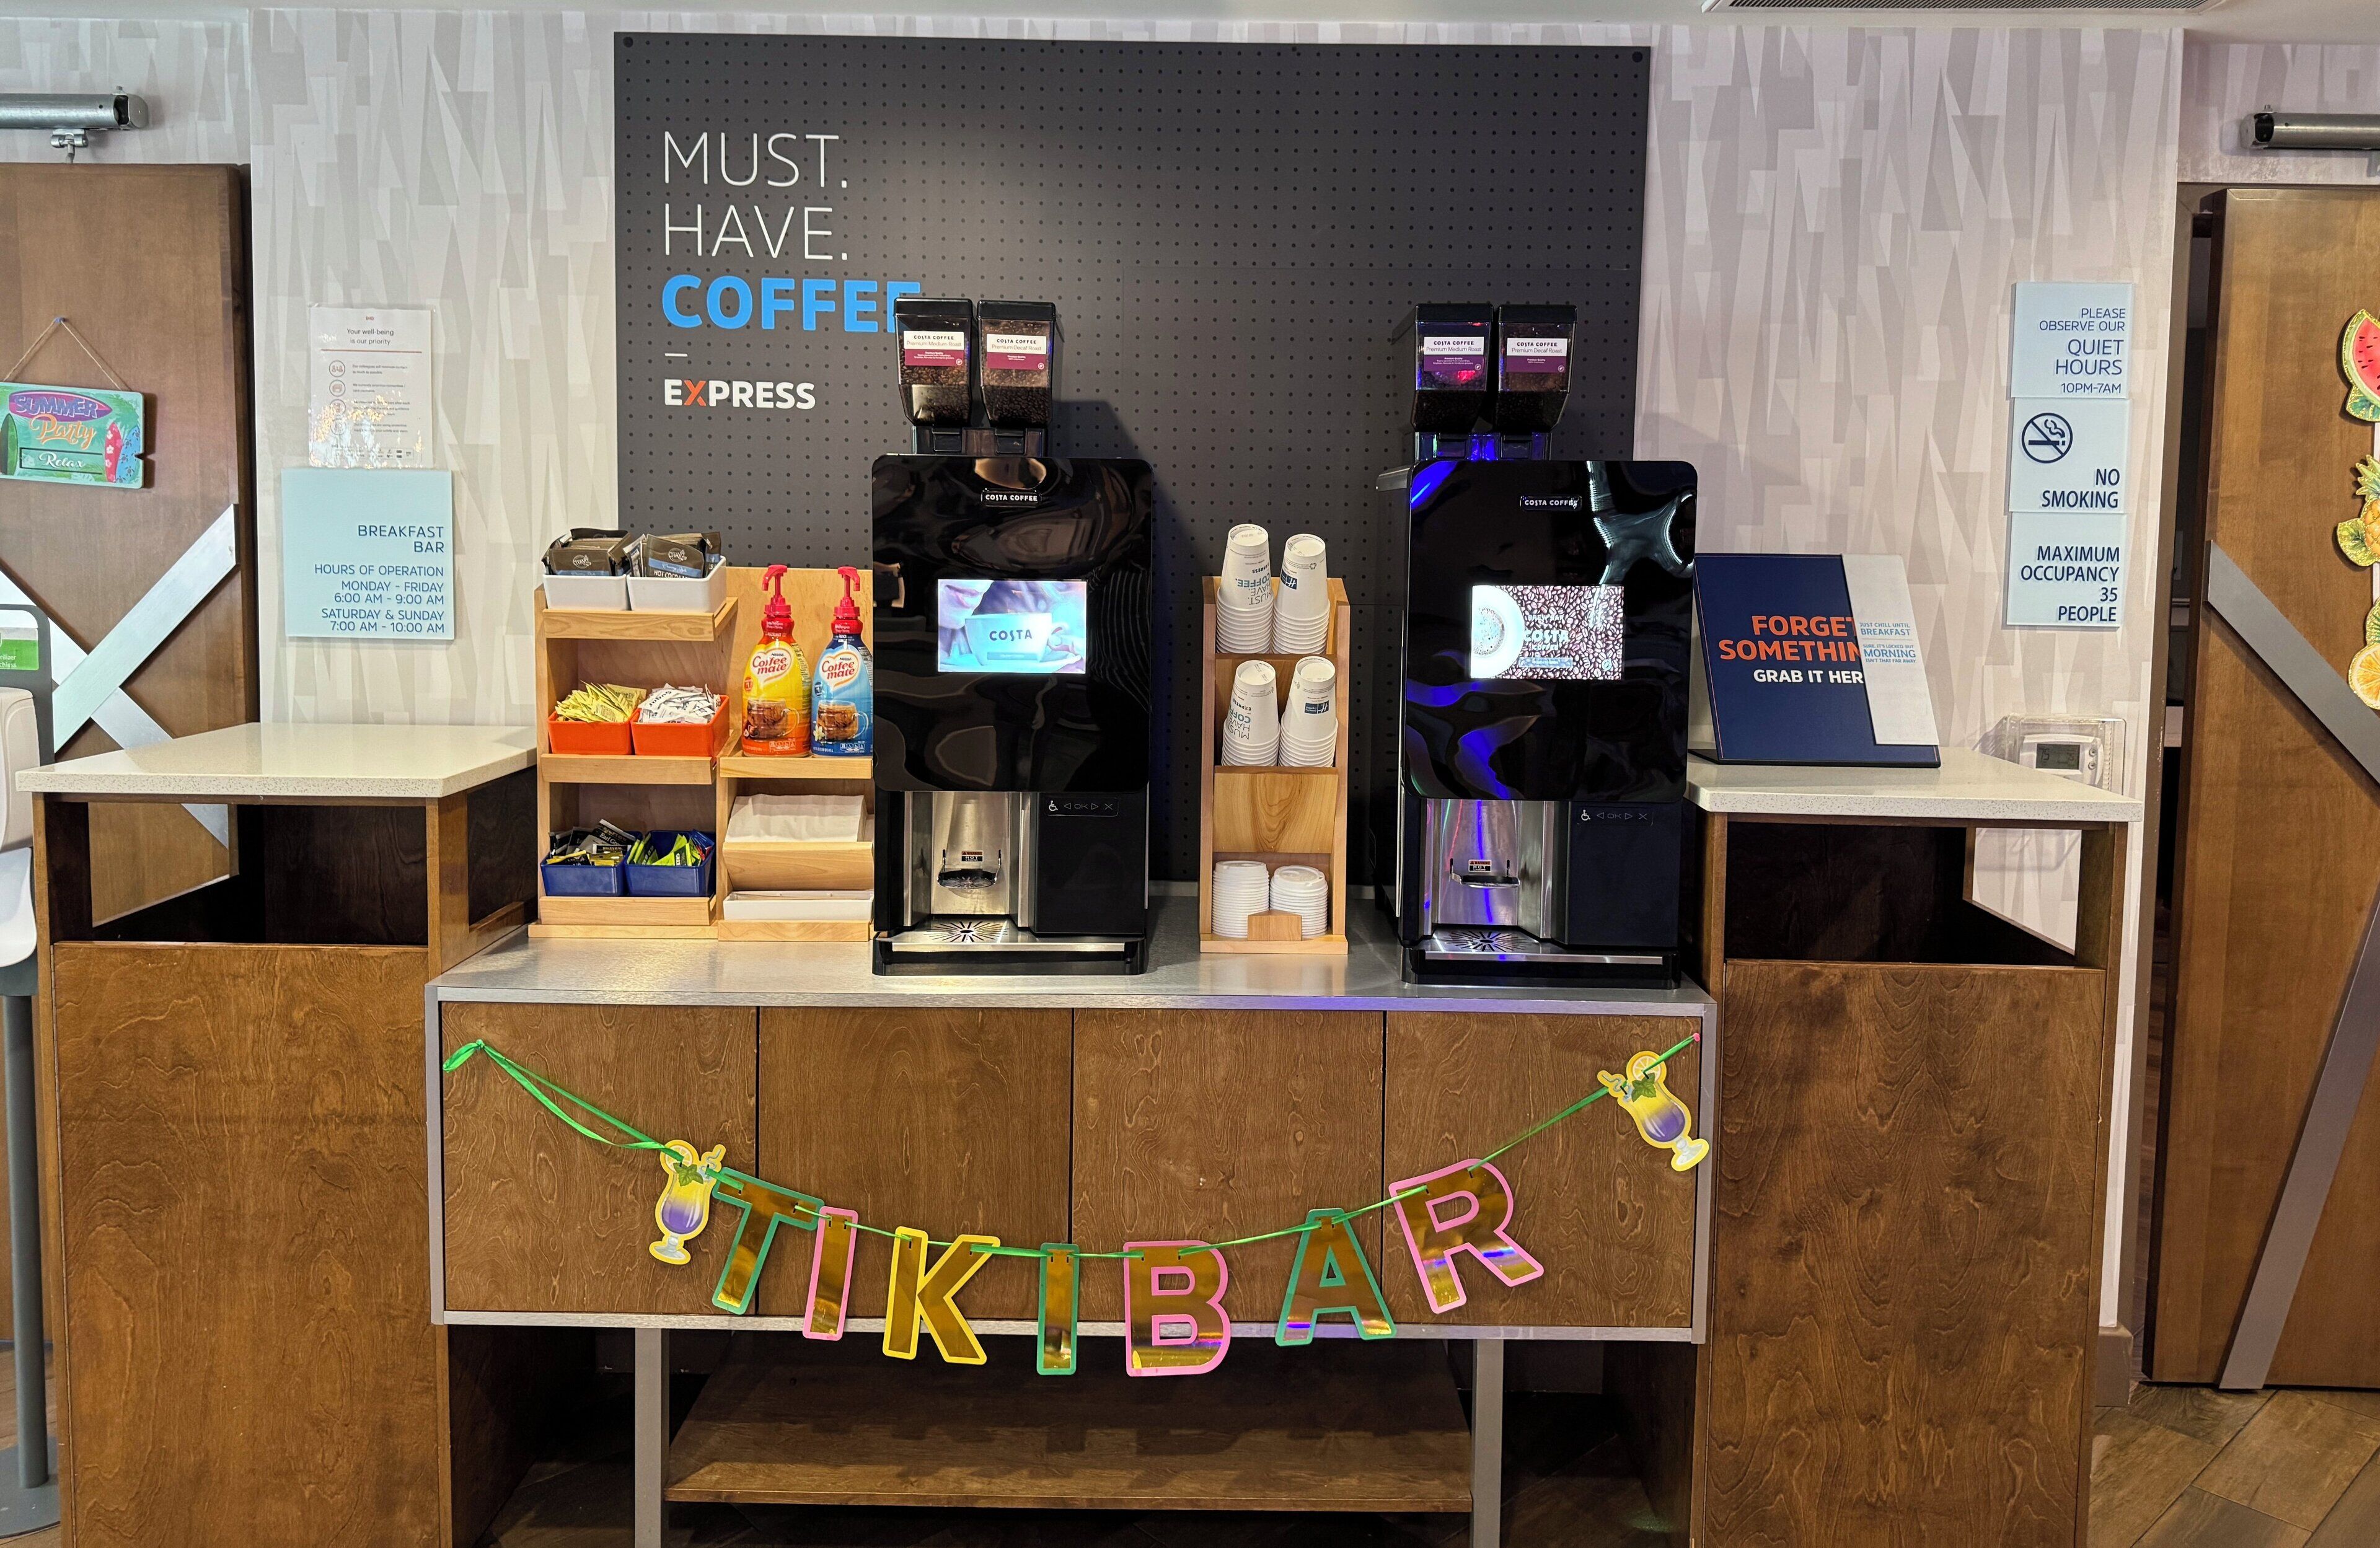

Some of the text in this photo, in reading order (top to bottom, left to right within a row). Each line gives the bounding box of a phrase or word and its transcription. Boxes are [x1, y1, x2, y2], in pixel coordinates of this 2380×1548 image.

[664, 131, 848, 188] MUST.
[664, 203, 848, 261] HAVE.
[2081, 308, 2126, 319] PLEASE
[362, 328, 394, 336] well-being
[2039, 320, 2125, 332] OBSERVE OUR
[2068, 339, 2125, 356] QUIET
[2056, 359, 2122, 375] HOURS
[664, 379, 816, 410] EXPRESS
[2061, 383, 2122, 394] 10PM-7AM
[14, 395, 99, 419] SUMMER
[30, 413, 97, 451] Party
[38, 452, 86, 468] Relax
[2096, 468, 2120, 486] NO
[1010, 494, 1038, 502] COFFEE
[2042, 490, 2118, 508] SMOKING
[358, 525, 444, 538] BREAKFAST
[413, 541, 444, 553] BAR
[2037, 546, 2120, 562] MAXIMUM
[315, 564, 444, 576] HOURS OF OPERATION
[654, 570, 664, 578] HOT
[2021, 565, 2120, 582] OCCUPANCY
[341, 581, 391, 591] MONDAY
[404, 581, 444, 592] FRIDAY
[334, 592, 360, 603] 6:00
[365, 593, 382, 604] AM
[395, 594, 422, 604] 9:00
[426, 595, 444, 605] AM
[2100, 587, 2118, 602] 35
[322, 608, 444, 620] SATURDAY & SUNDAY
[2058, 605, 2117, 622] PEOPLE
[330, 620, 355, 631] 7:00
[359, 621, 377, 631] AM
[390, 622, 422, 632] 10:00
[427, 623, 444, 633] AM
[989, 629, 1033, 642] COSTA
[1524, 629, 1569, 644] COSTA
[1719, 640, 1861, 662] SOMETHIN
[1864, 649, 1916, 658] MORNING
[752, 656, 787, 667] Coffee
[822, 661, 855, 673] Coffee
[757, 664, 787, 674] mate
[827, 669, 855, 679] mate
[1753, 669, 1864, 684] GRAB IT HER
[711, 1167, 1080, 1376] TIKI
[1122, 1158, 1545, 1377] BAR
